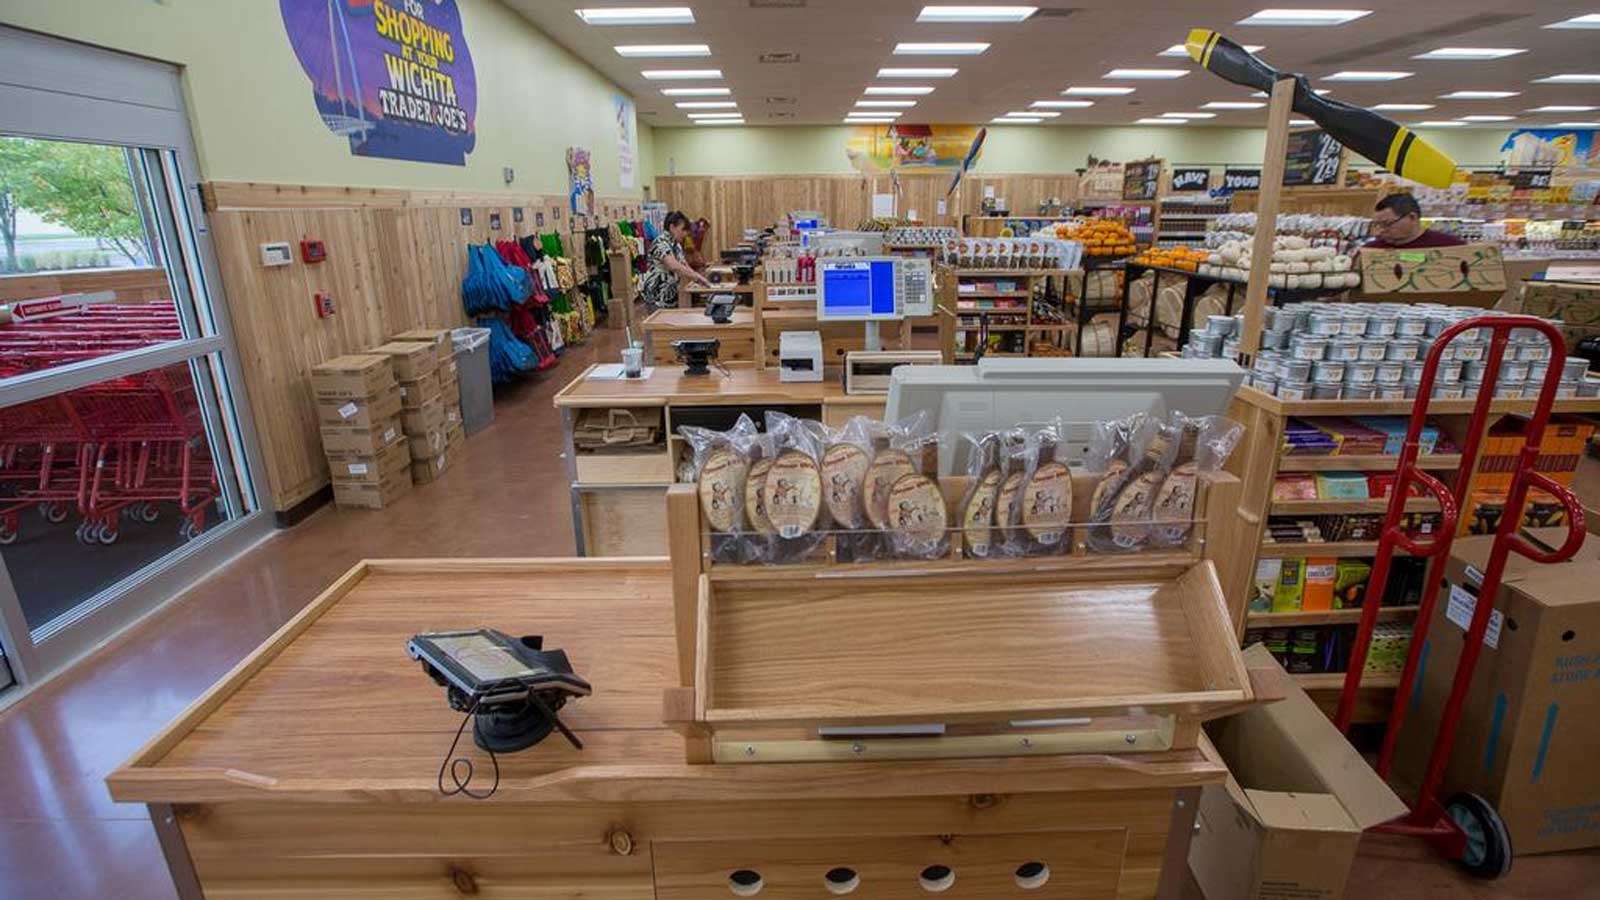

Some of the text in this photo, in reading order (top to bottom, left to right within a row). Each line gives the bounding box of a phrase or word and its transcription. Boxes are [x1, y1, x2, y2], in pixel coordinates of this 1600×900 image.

[404, 0, 424, 20] FOR
[375, 0, 454, 62] SHOPPING
[402, 44, 438, 70] AT YOUR
[384, 53, 457, 107] WICHITA
[379, 89, 467, 131] TRADER JOE'S
[1226, 175, 1259, 189] YOUR
